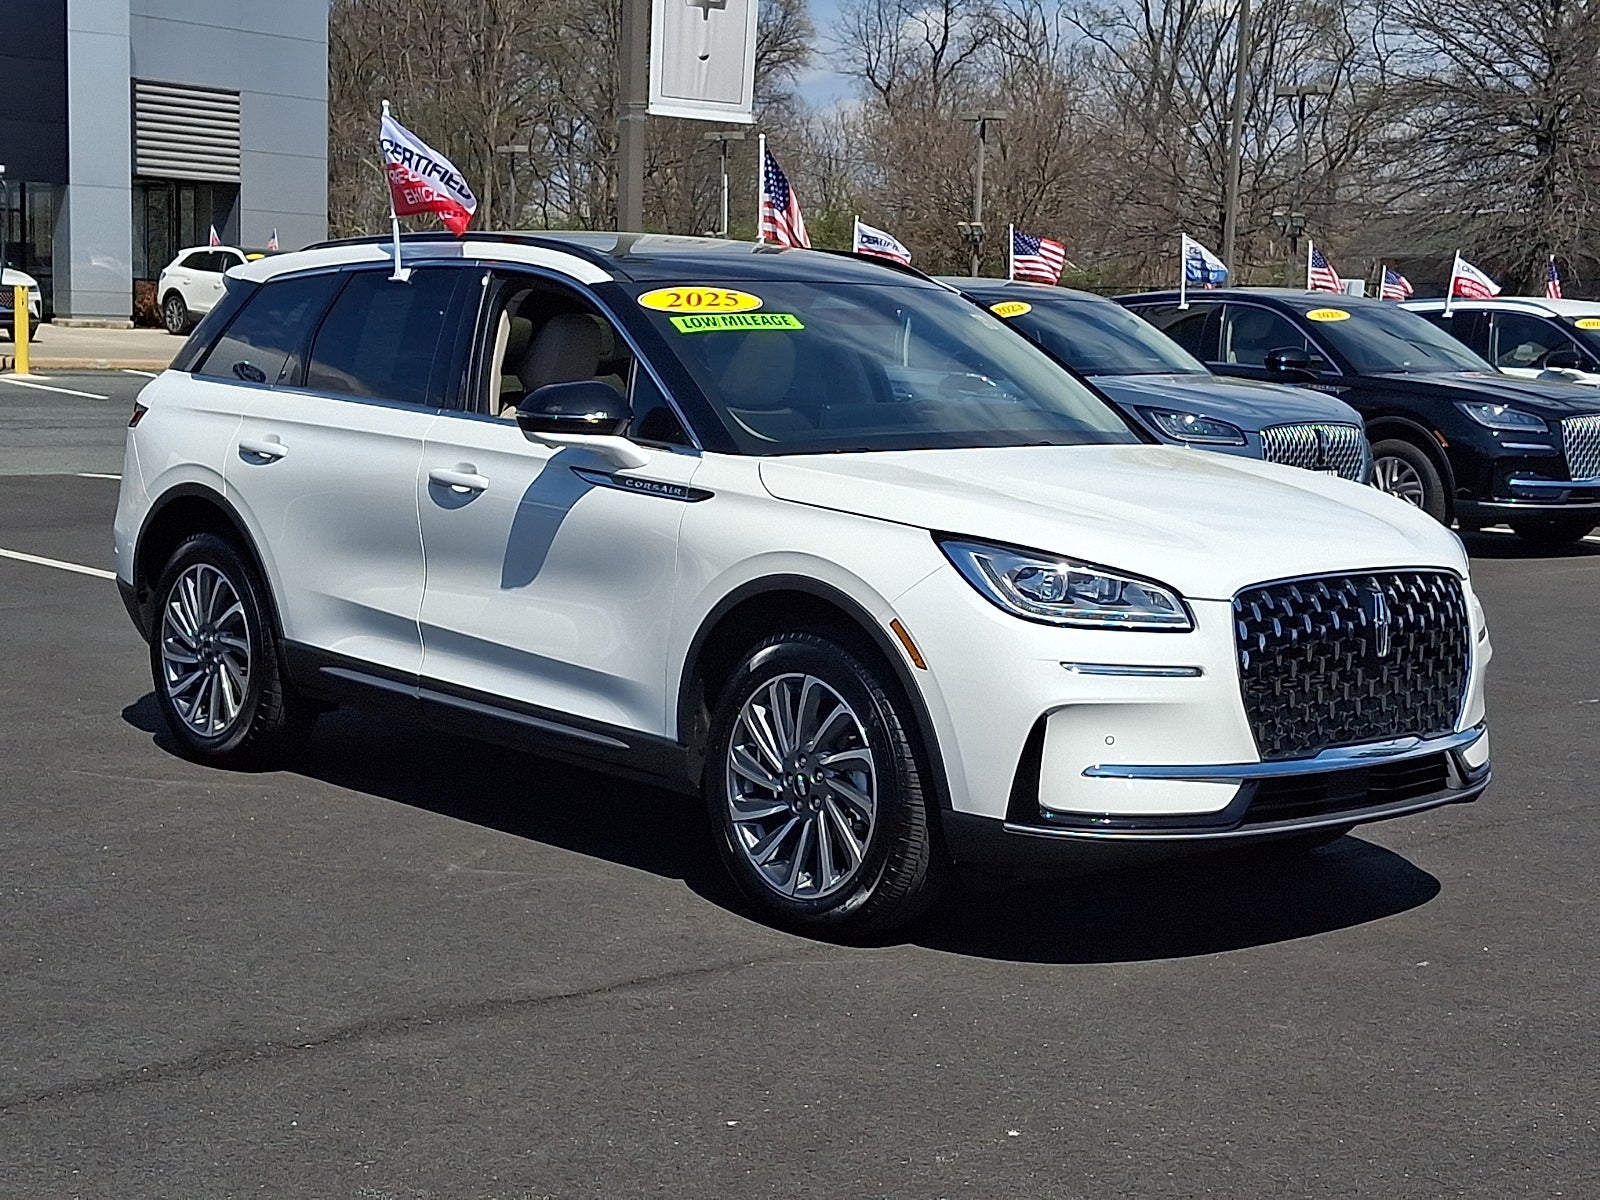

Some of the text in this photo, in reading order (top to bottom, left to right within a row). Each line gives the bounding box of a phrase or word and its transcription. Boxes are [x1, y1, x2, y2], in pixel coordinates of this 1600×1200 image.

[380, 138, 473, 200] CERTIFIED
[403, 186, 448, 205] EHICL
[666, 292, 739, 308] 2025
[681, 314, 792, 329] LOW MILEAGE
[625, 479, 682, 496] CORSAIR
